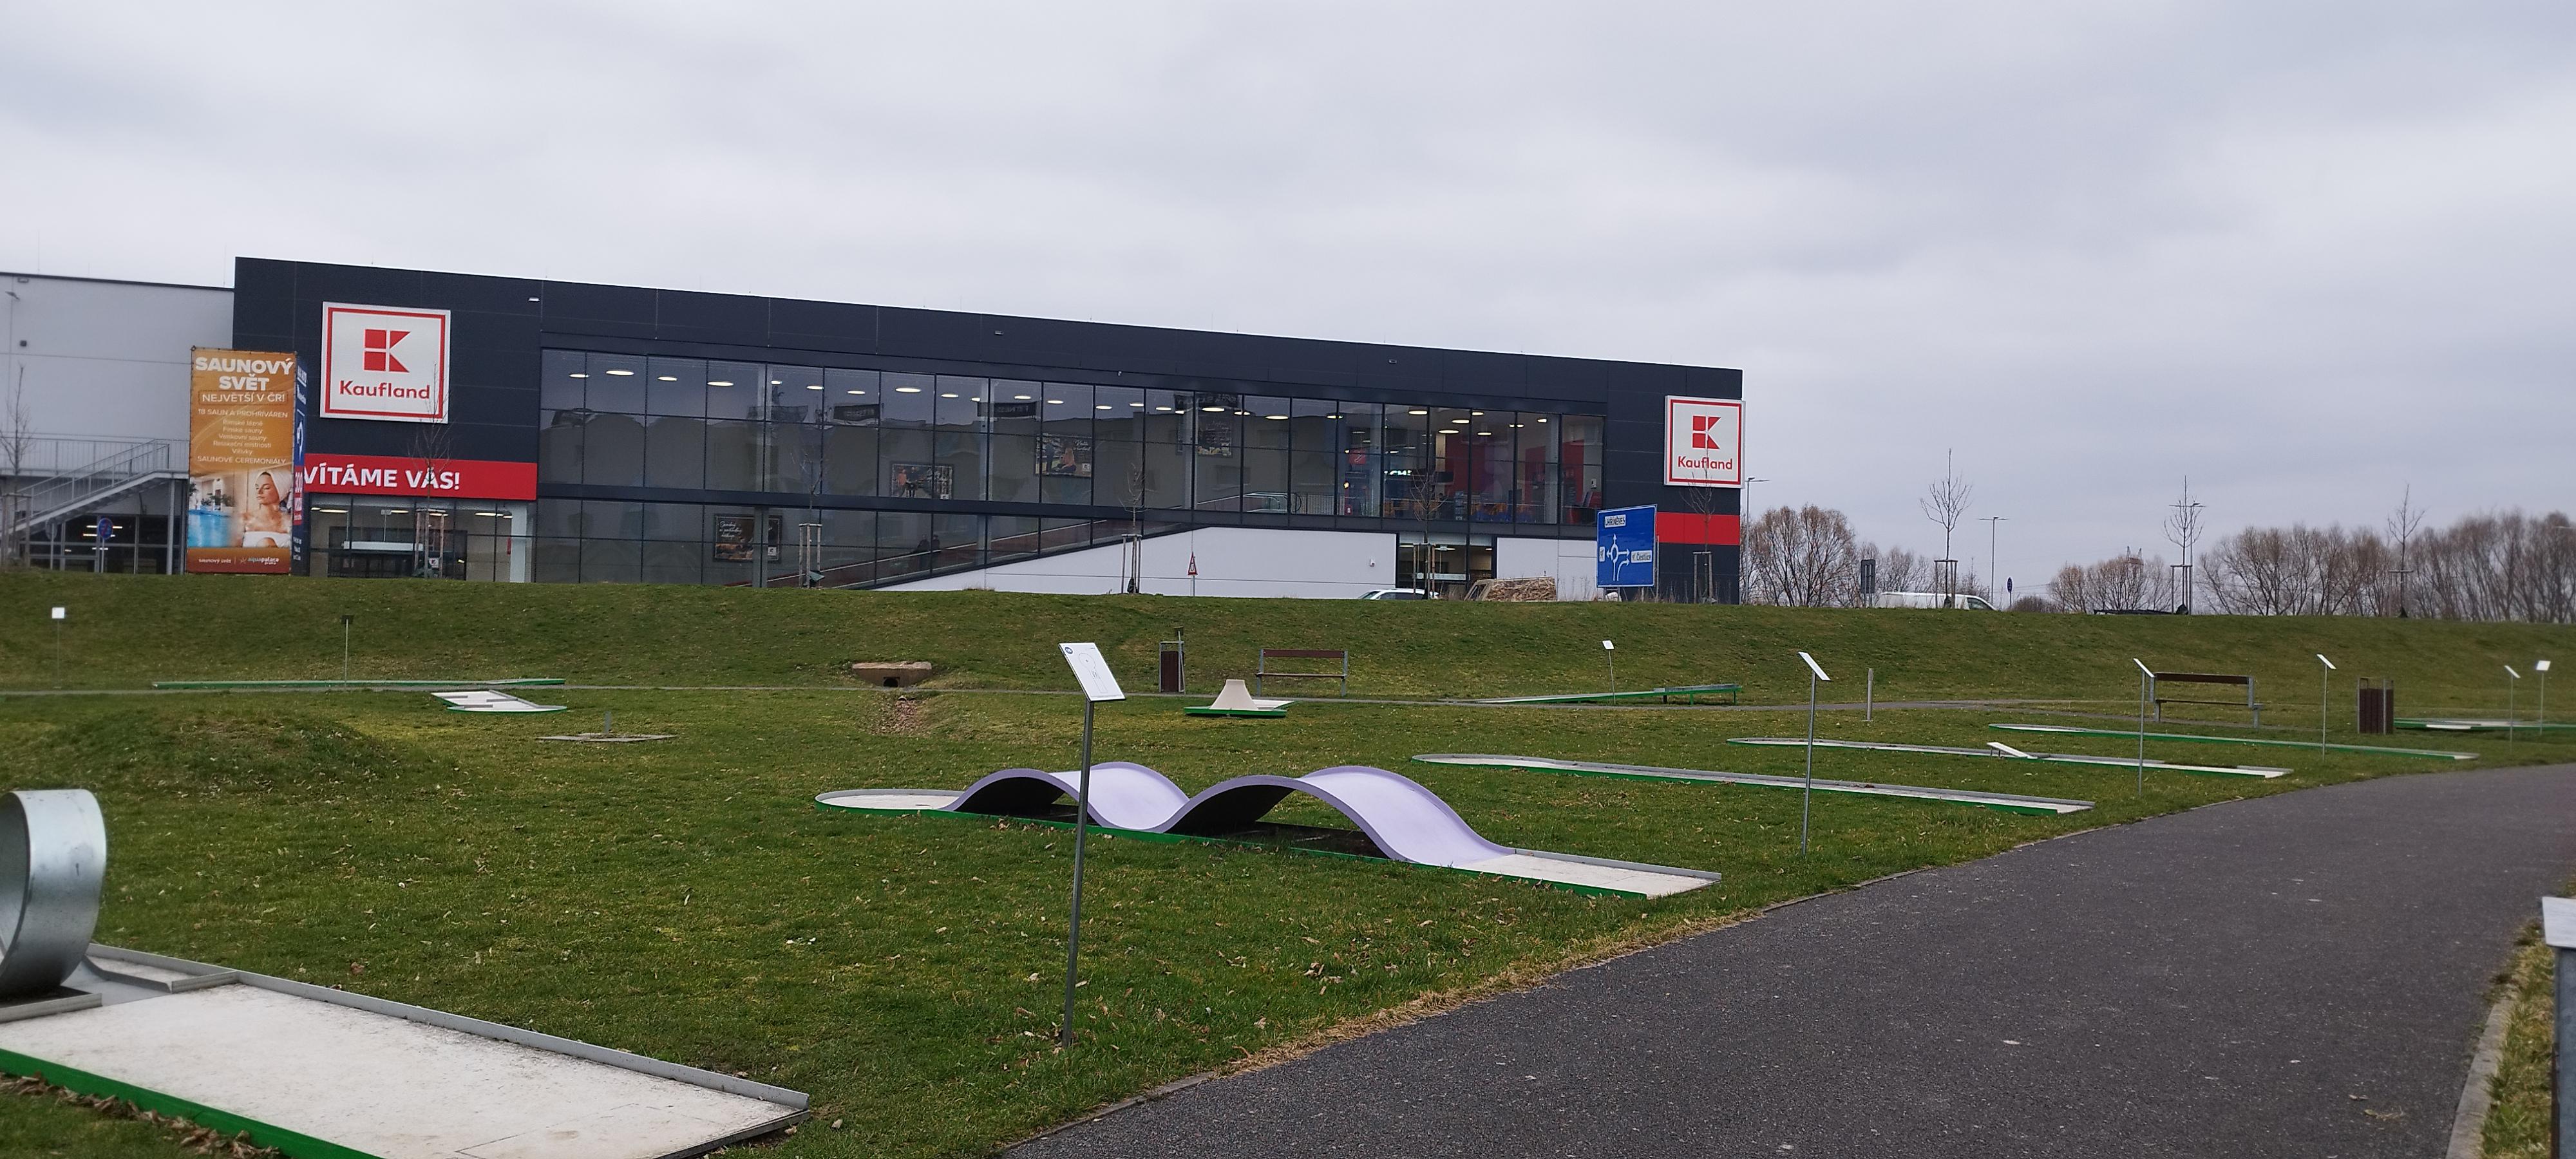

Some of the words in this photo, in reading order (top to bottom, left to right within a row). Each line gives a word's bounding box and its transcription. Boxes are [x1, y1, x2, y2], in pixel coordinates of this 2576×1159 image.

[195, 357, 294, 375] SAUNOVÝ
[218, 373, 270, 391] SVĚT
[339, 380, 430, 400] Kaufland
[202, 391, 254, 402] NEJVĚTŠÍ
[257, 393, 265, 402] V
[267, 392, 285, 402] ČR!
[1677, 455, 1734, 469] Kaufland
[303, 462, 397, 487] VÍTÁME
[405, 466, 460, 490] VÁS!
